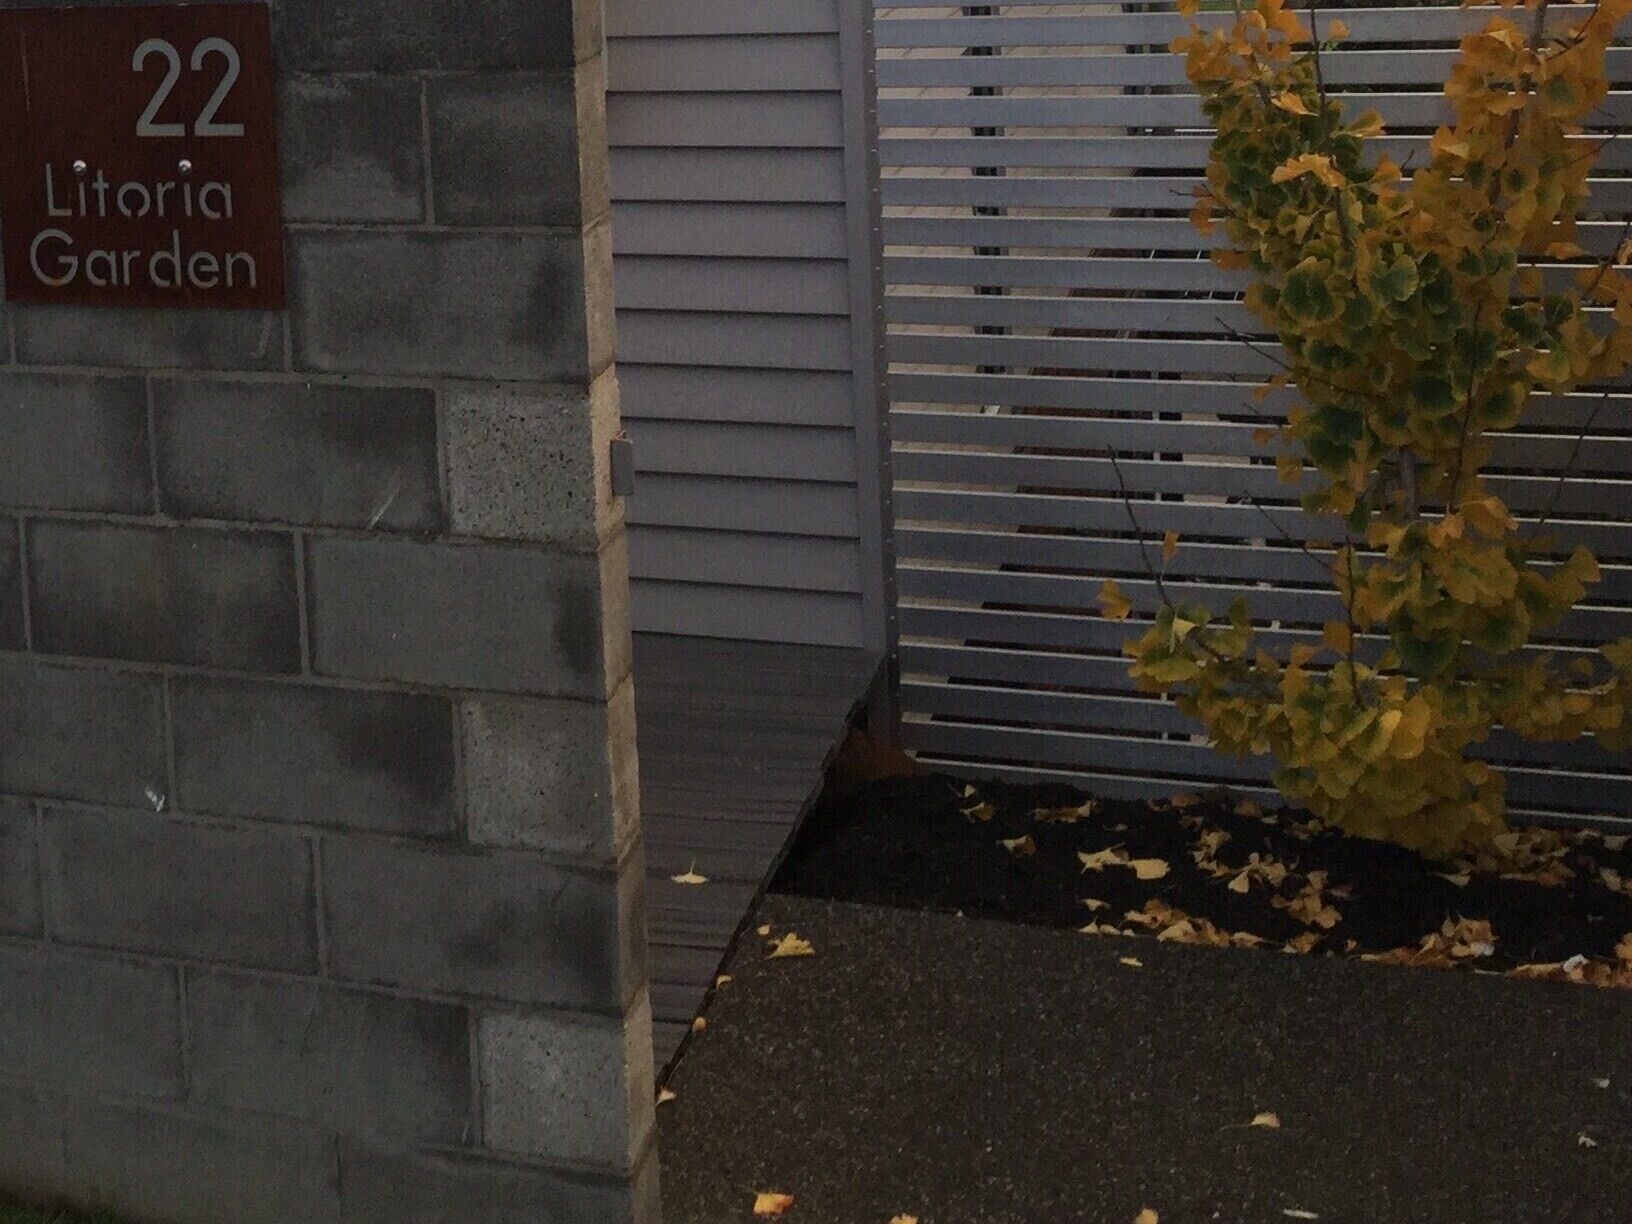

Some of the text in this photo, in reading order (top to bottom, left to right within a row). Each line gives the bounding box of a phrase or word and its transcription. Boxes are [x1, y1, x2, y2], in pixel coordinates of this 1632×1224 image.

[131, 36, 245, 137] 22
[45, 160, 233, 219] Litoria
[29, 228, 257, 288] Garden
